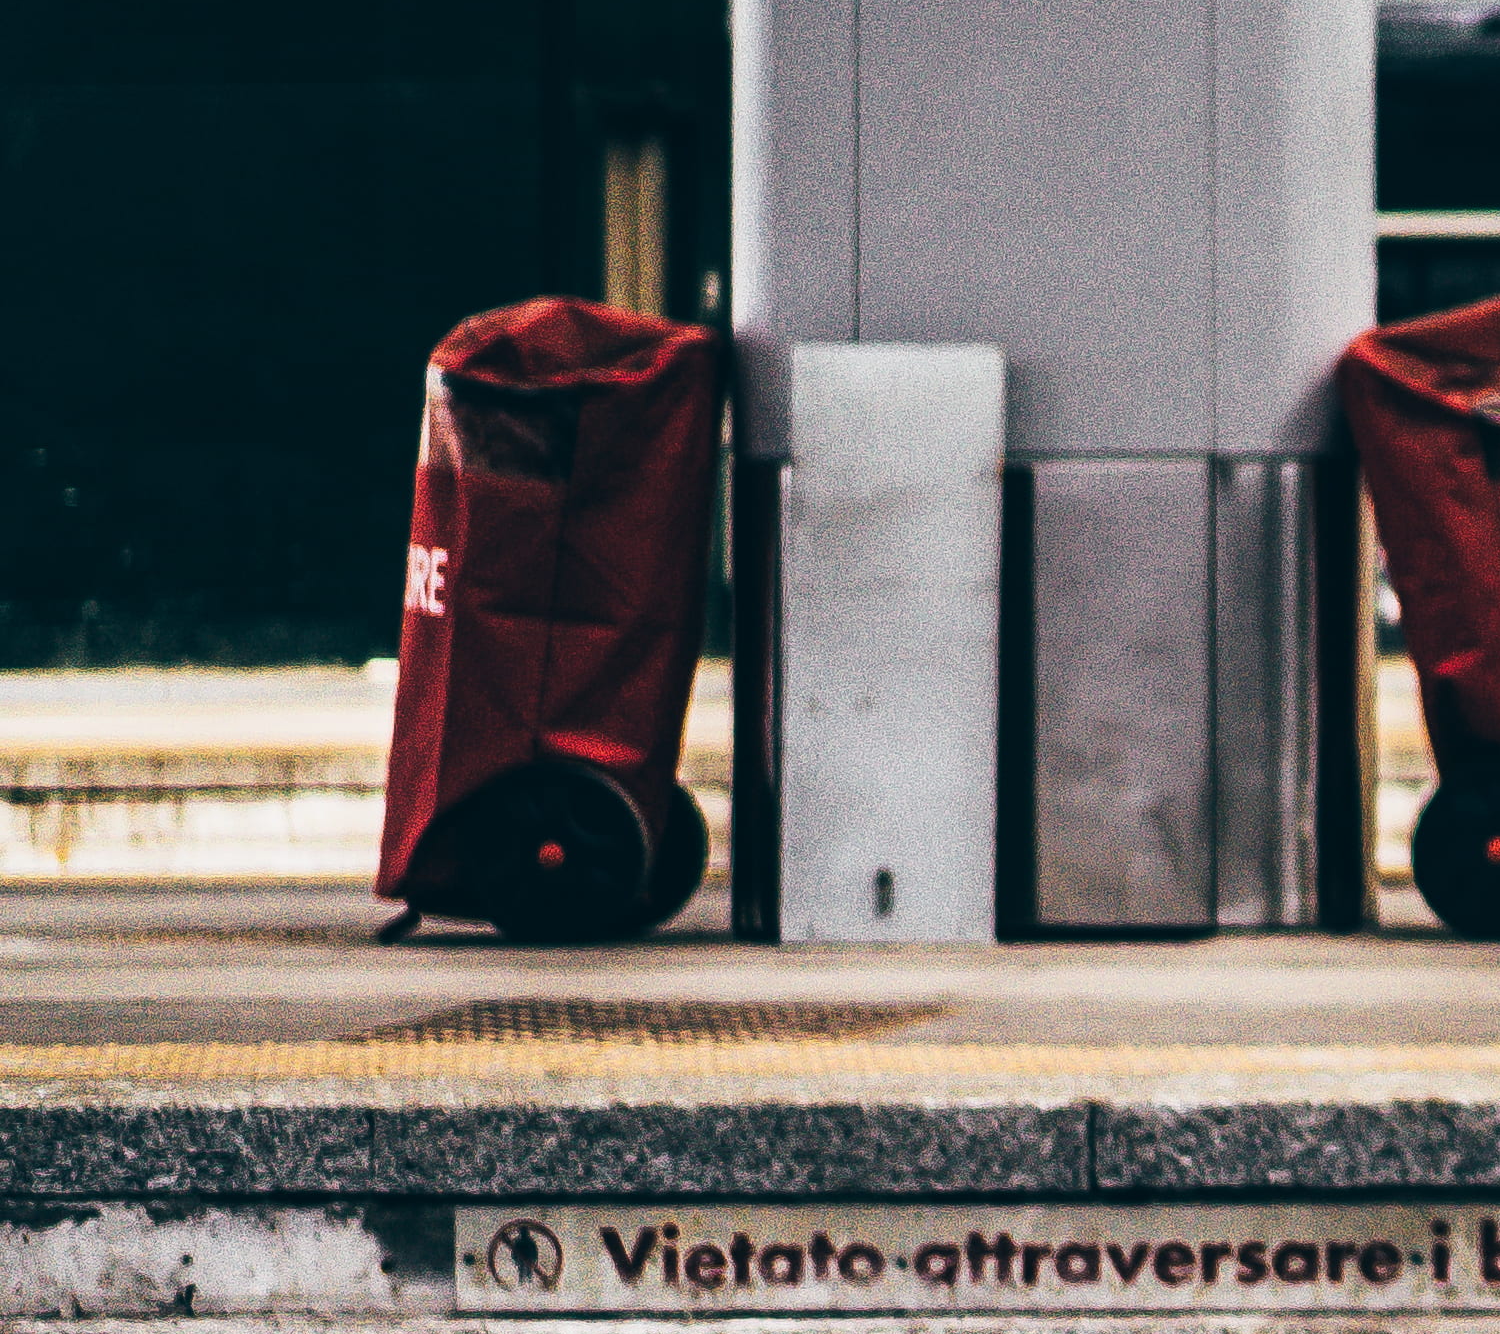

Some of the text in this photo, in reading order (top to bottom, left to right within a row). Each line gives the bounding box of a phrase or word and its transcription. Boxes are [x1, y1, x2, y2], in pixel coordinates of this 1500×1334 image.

[601, 1221, 887, 1288] Vietato
[913, 1229, 1403, 1286] attraversare
[1431, 1218, 1451, 1284] i
